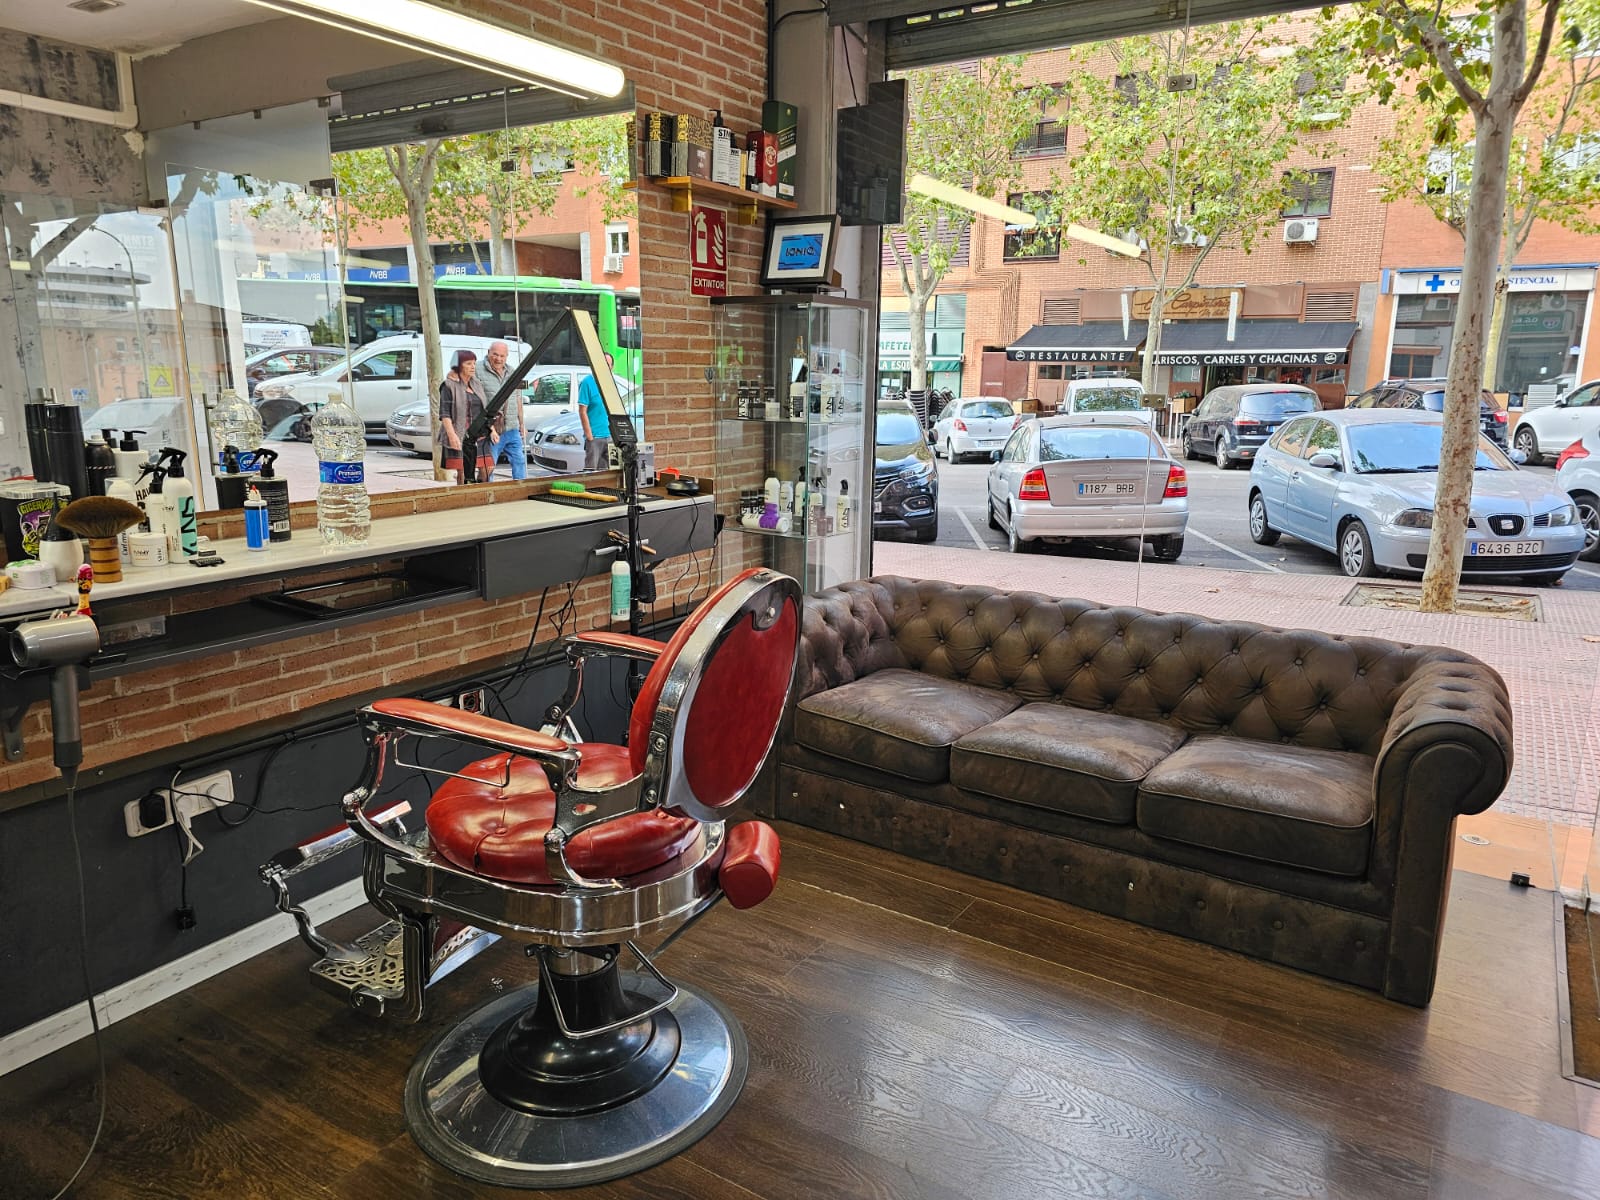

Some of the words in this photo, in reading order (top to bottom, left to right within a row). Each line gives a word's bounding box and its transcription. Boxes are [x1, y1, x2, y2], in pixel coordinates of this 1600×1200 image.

[693, 277, 725, 290] EXTINTOR
[1507, 276, 1558, 285] STENCIAL
[1029, 351, 1126, 362] RESTAURANTE
[1203, 354, 1246, 365] CARNES
[1248, 354, 1256, 364] Y
[1258, 353, 1318, 364] CHACINAS
[891, 360, 934, 370] ESQA
[1085, 484, 1108, 494] 1187
[1478, 543, 1511, 554] 6436
[1516, 542, 1540, 554] BZC
